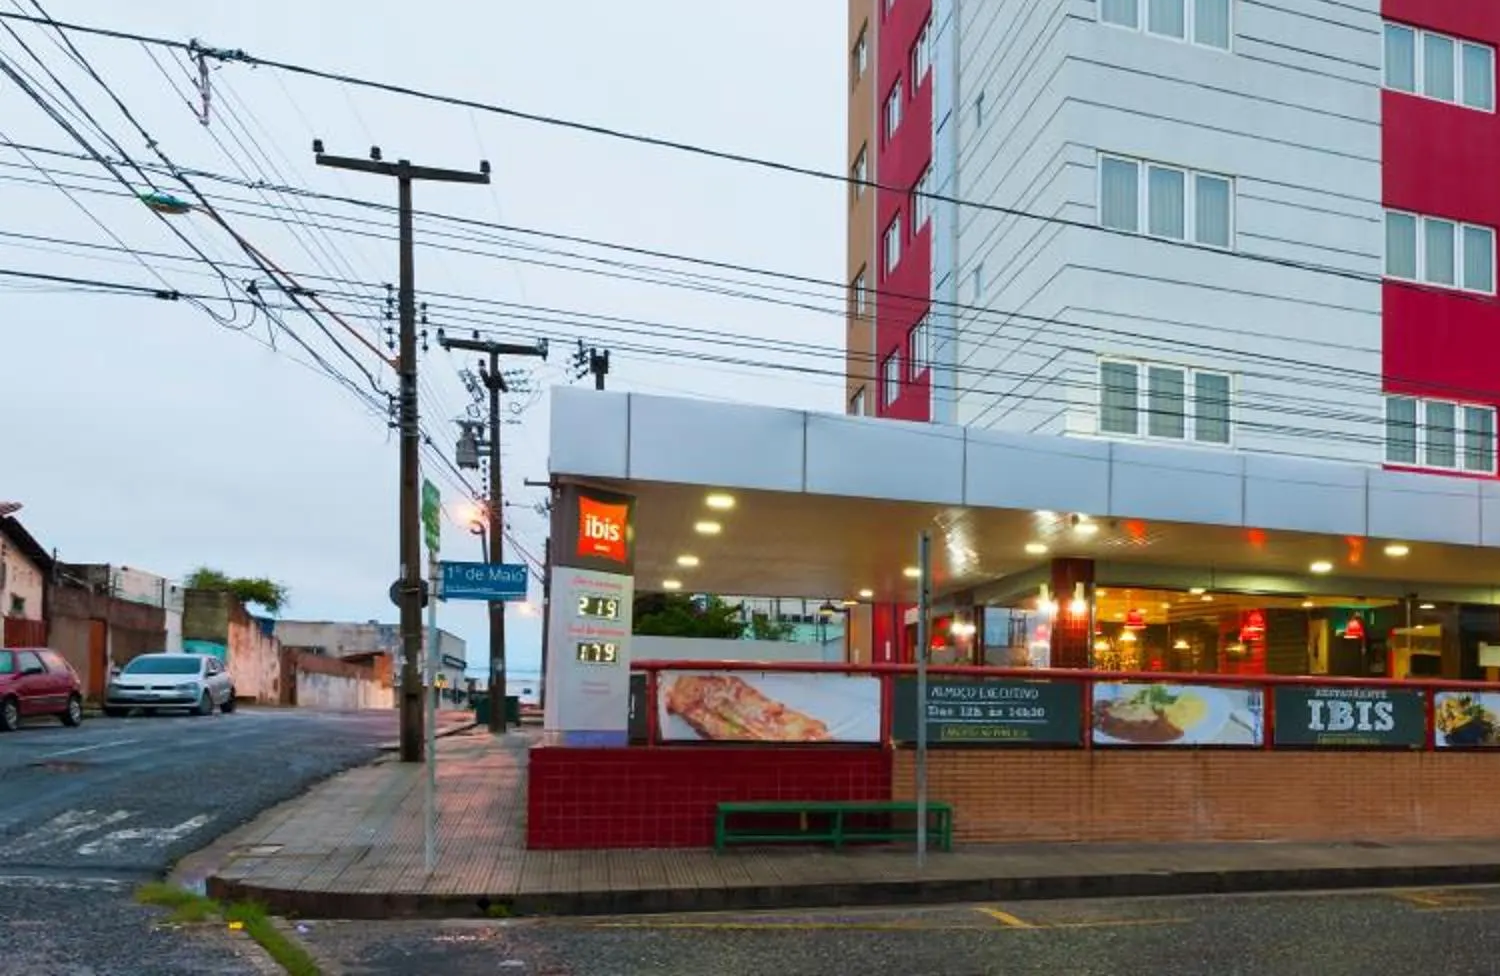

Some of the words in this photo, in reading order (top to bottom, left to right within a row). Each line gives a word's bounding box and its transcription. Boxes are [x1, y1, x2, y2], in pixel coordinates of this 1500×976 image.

[585, 514, 620, 542] ibis
[465, 567, 481, 581] de
[489, 567, 525, 583] Maio
[577, 597, 617, 620] 219
[579, 643, 616, 662] 179
[1307, 699, 1395, 731] IBIS
